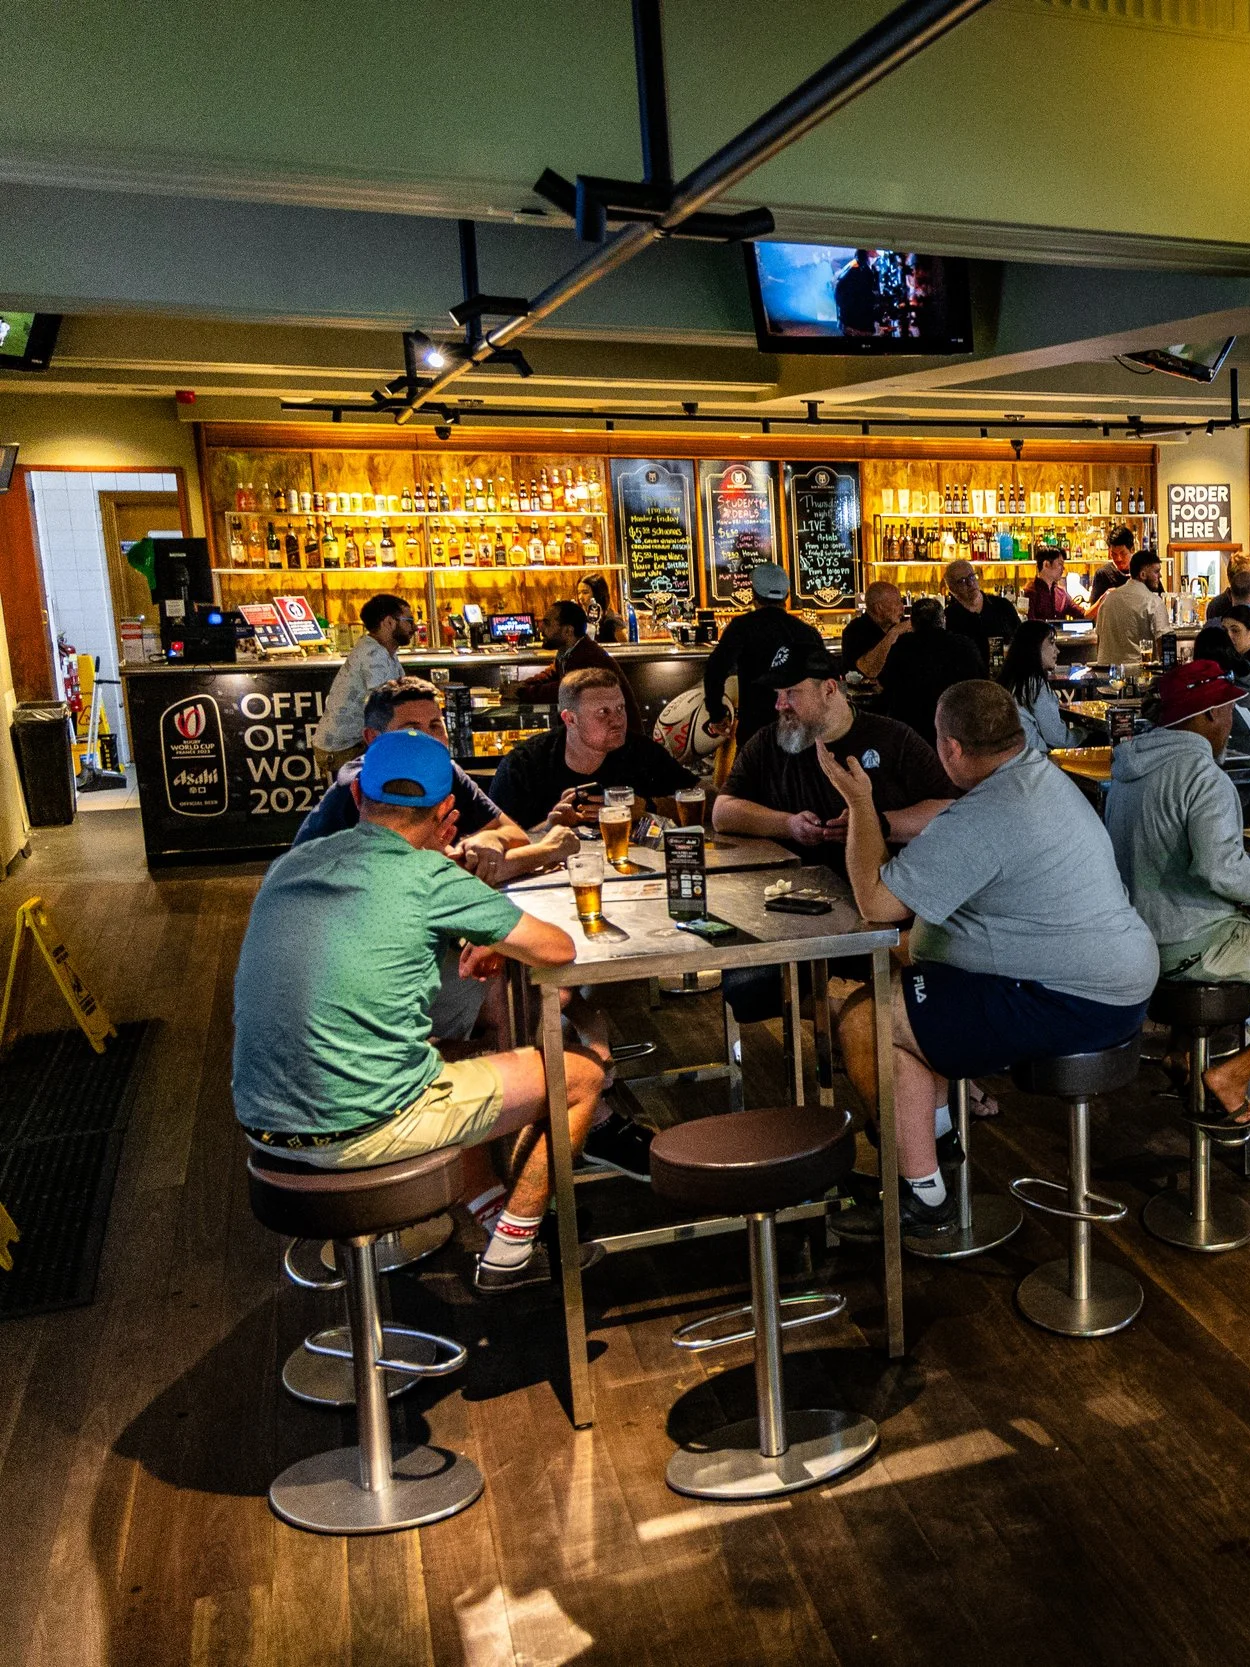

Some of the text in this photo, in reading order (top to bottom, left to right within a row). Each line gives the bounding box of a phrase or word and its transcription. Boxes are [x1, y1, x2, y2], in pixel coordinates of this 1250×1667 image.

[1170, 485, 1229, 502] ORDER
[1171, 504, 1220, 520] FOOD
[799, 520, 826, 532] LIVE
[1170, 521, 1214, 538] HERE
[240, 691, 324, 720] OFFI
[243, 724, 295, 752] OF
[173, 767, 219, 787] Asahi
[912, 974, 927, 1004] FILA
